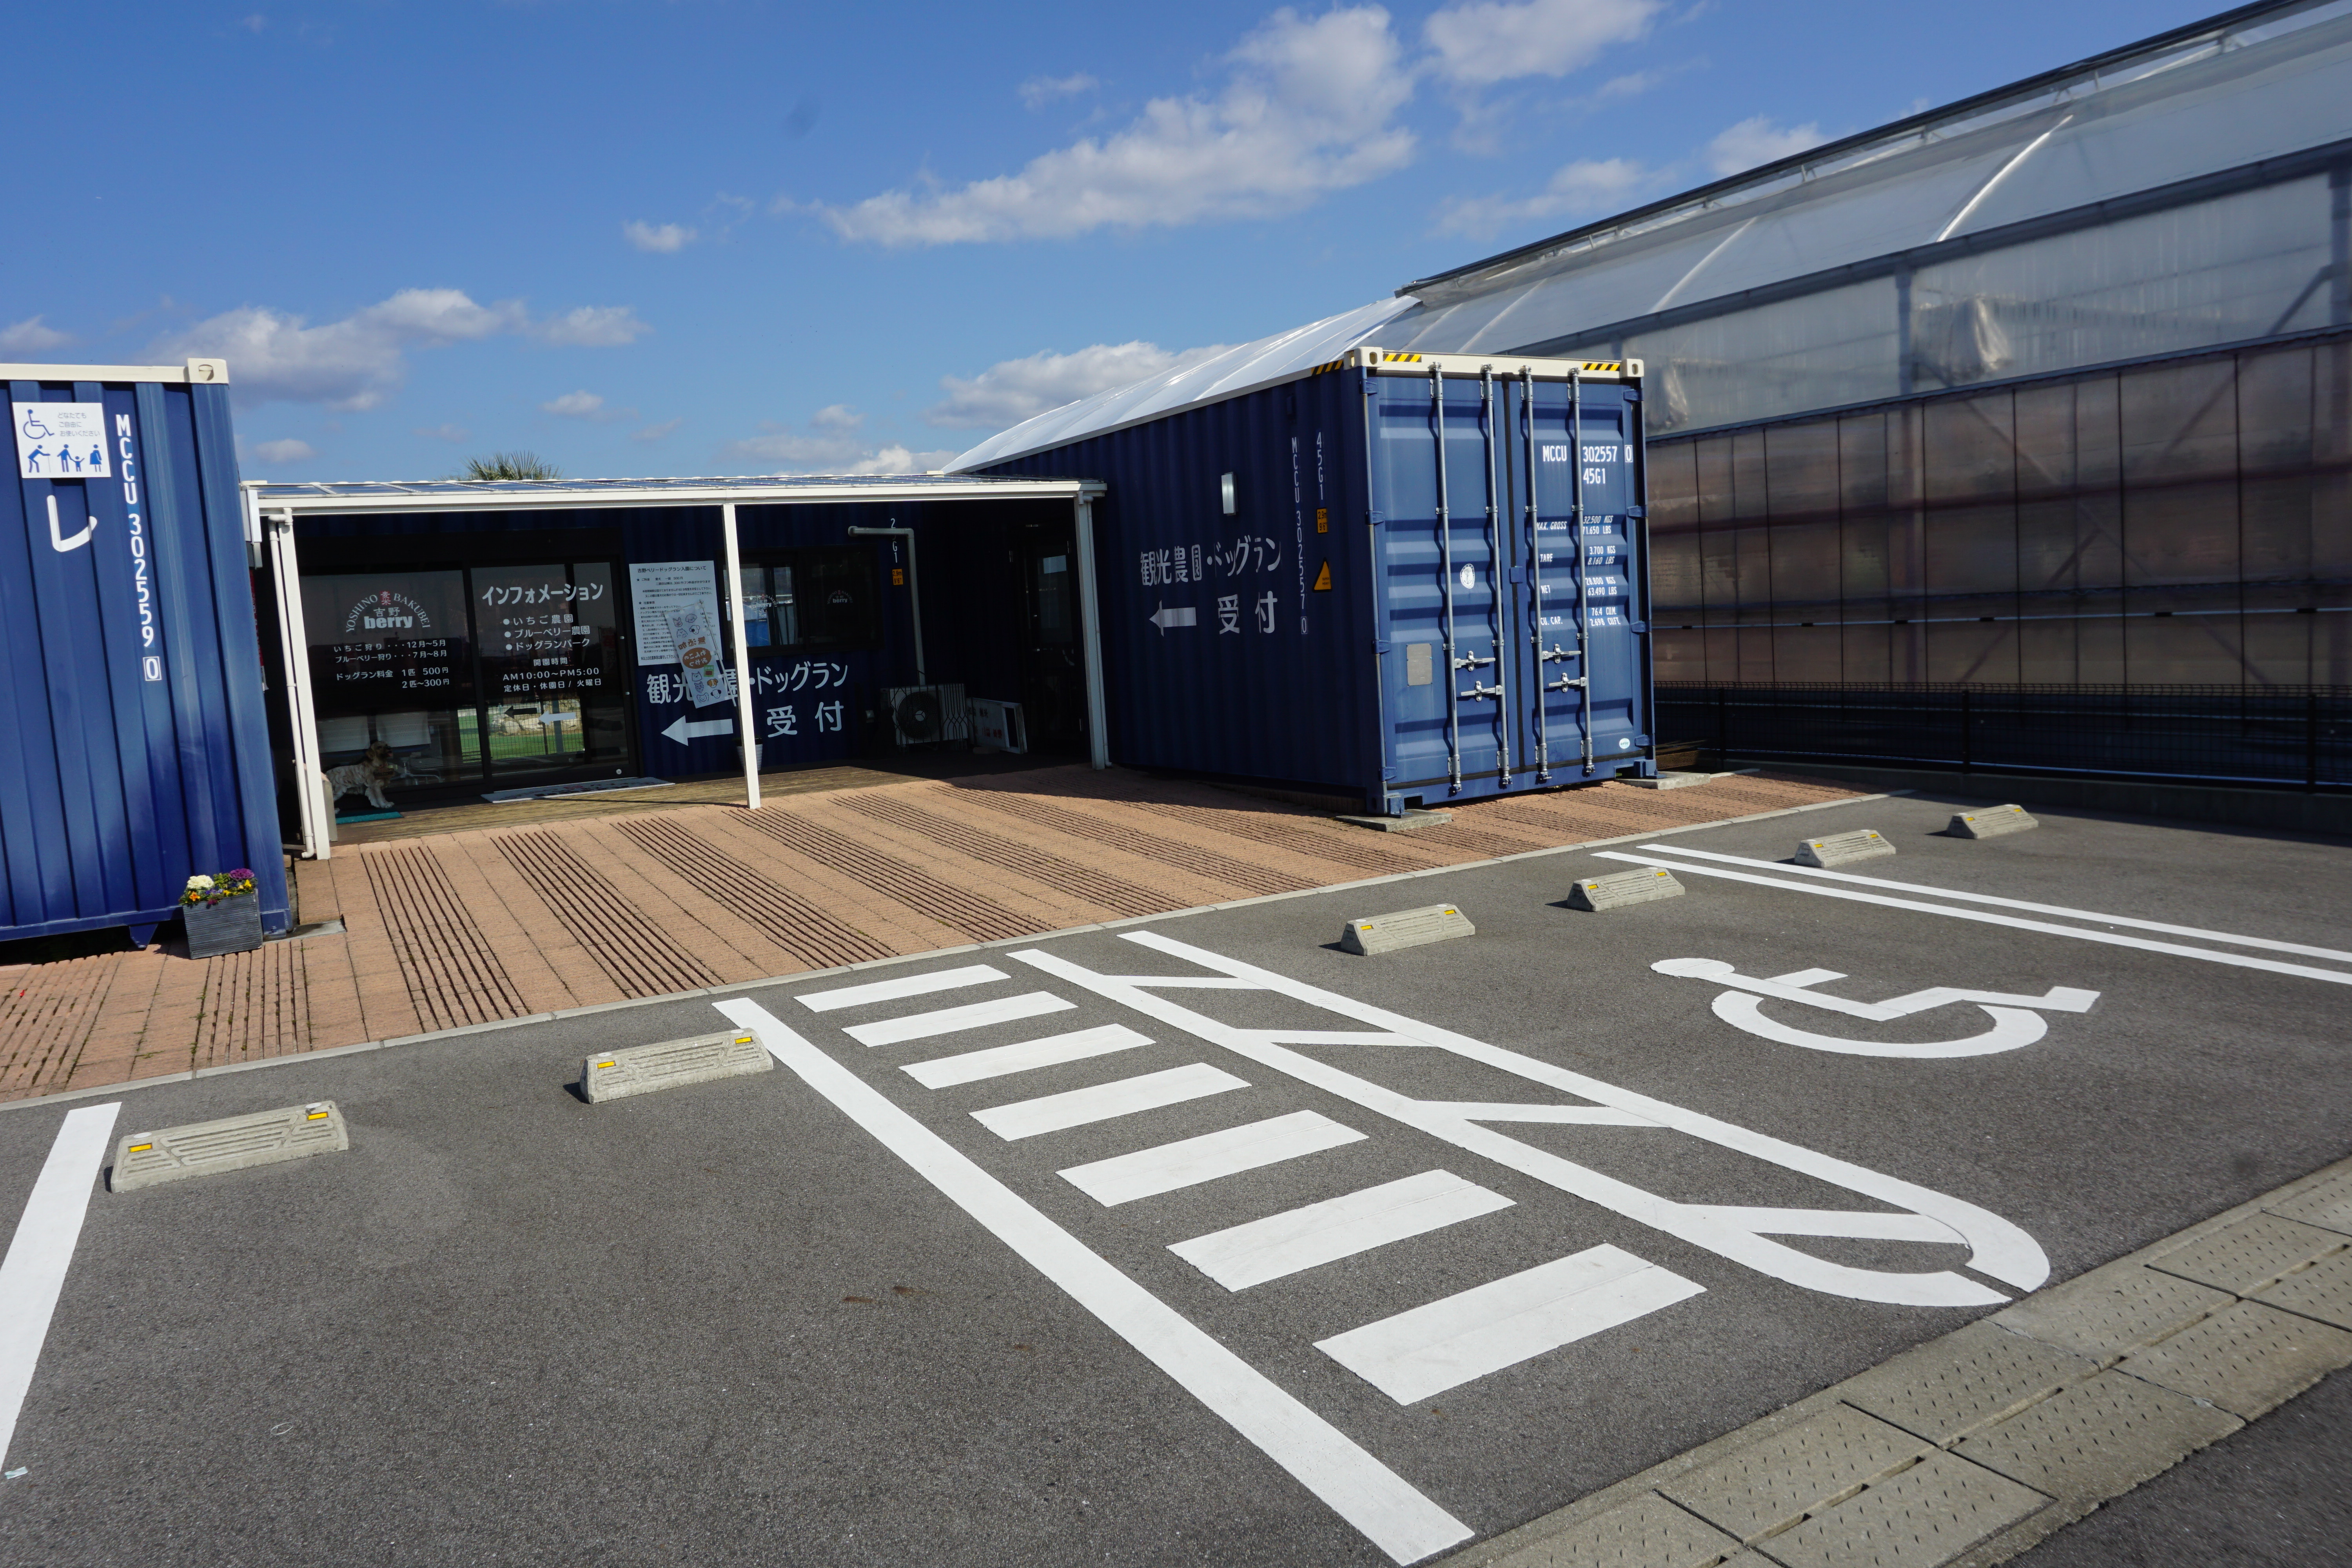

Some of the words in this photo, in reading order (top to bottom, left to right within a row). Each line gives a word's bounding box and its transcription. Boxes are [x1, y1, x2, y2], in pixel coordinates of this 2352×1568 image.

[1543, 446, 1567, 462] MCCU
[1583, 446, 1617, 462] 302557
[1626, 446, 1632, 461] 0
[1583, 468, 1606, 484] 45G1
[116, 414, 137, 504] MCCU
[129, 514, 153, 647] 302559
[1537, 522, 1548, 530] MAX.
[1550, 521, 1567, 530] GROSS
[1583, 526, 1599, 534] 71.650
[1603, 526, 1612, 534] LBS
[1589, 546, 1604, 555] 3.700
[1607, 545, 1615, 554] KGS
[1296, 510, 1305, 610] 302557
[1540, 554, 1553, 563] TARE
[1588, 557, 1602, 565] 8.160
[1585, 577, 1604, 585] 28.800
[483, 583, 603, 606] インフォメーション
[1541, 585, 1551, 593] NET
[1588, 587, 1605, 596] 63.490
[1608, 586, 1617, 595] LBS
[346, 594, 378, 633] YOSHINO
[373, 607, 400, 617] 吉野
[394, 593, 431, 628] BAKUBEI
[1217, 590, 1278, 635] 受付
[1592, 608, 1602, 616] 76.4
[364, 616, 413, 629] berry
[513, 613, 573, 626] いちご農園
[1540, 617, 1550, 626] CU.
[1550, 616, 1563, 625] CAP.
[1590, 618, 1605, 626] 2.698
[514, 625, 590, 639] ブルーベリー農園
[515, 638, 590, 651] ドッグランパーク
[533, 657, 568, 667] 開園時間
[336, 670, 394, 681] ドッグラン料金
[401, 668, 416, 677] 1匹
[423, 667, 449, 675] 500円
[504, 681, 565, 693] 定休日・休園日
[577, 678, 602, 687] 火曜日
[767, 700, 844, 738] 受付
